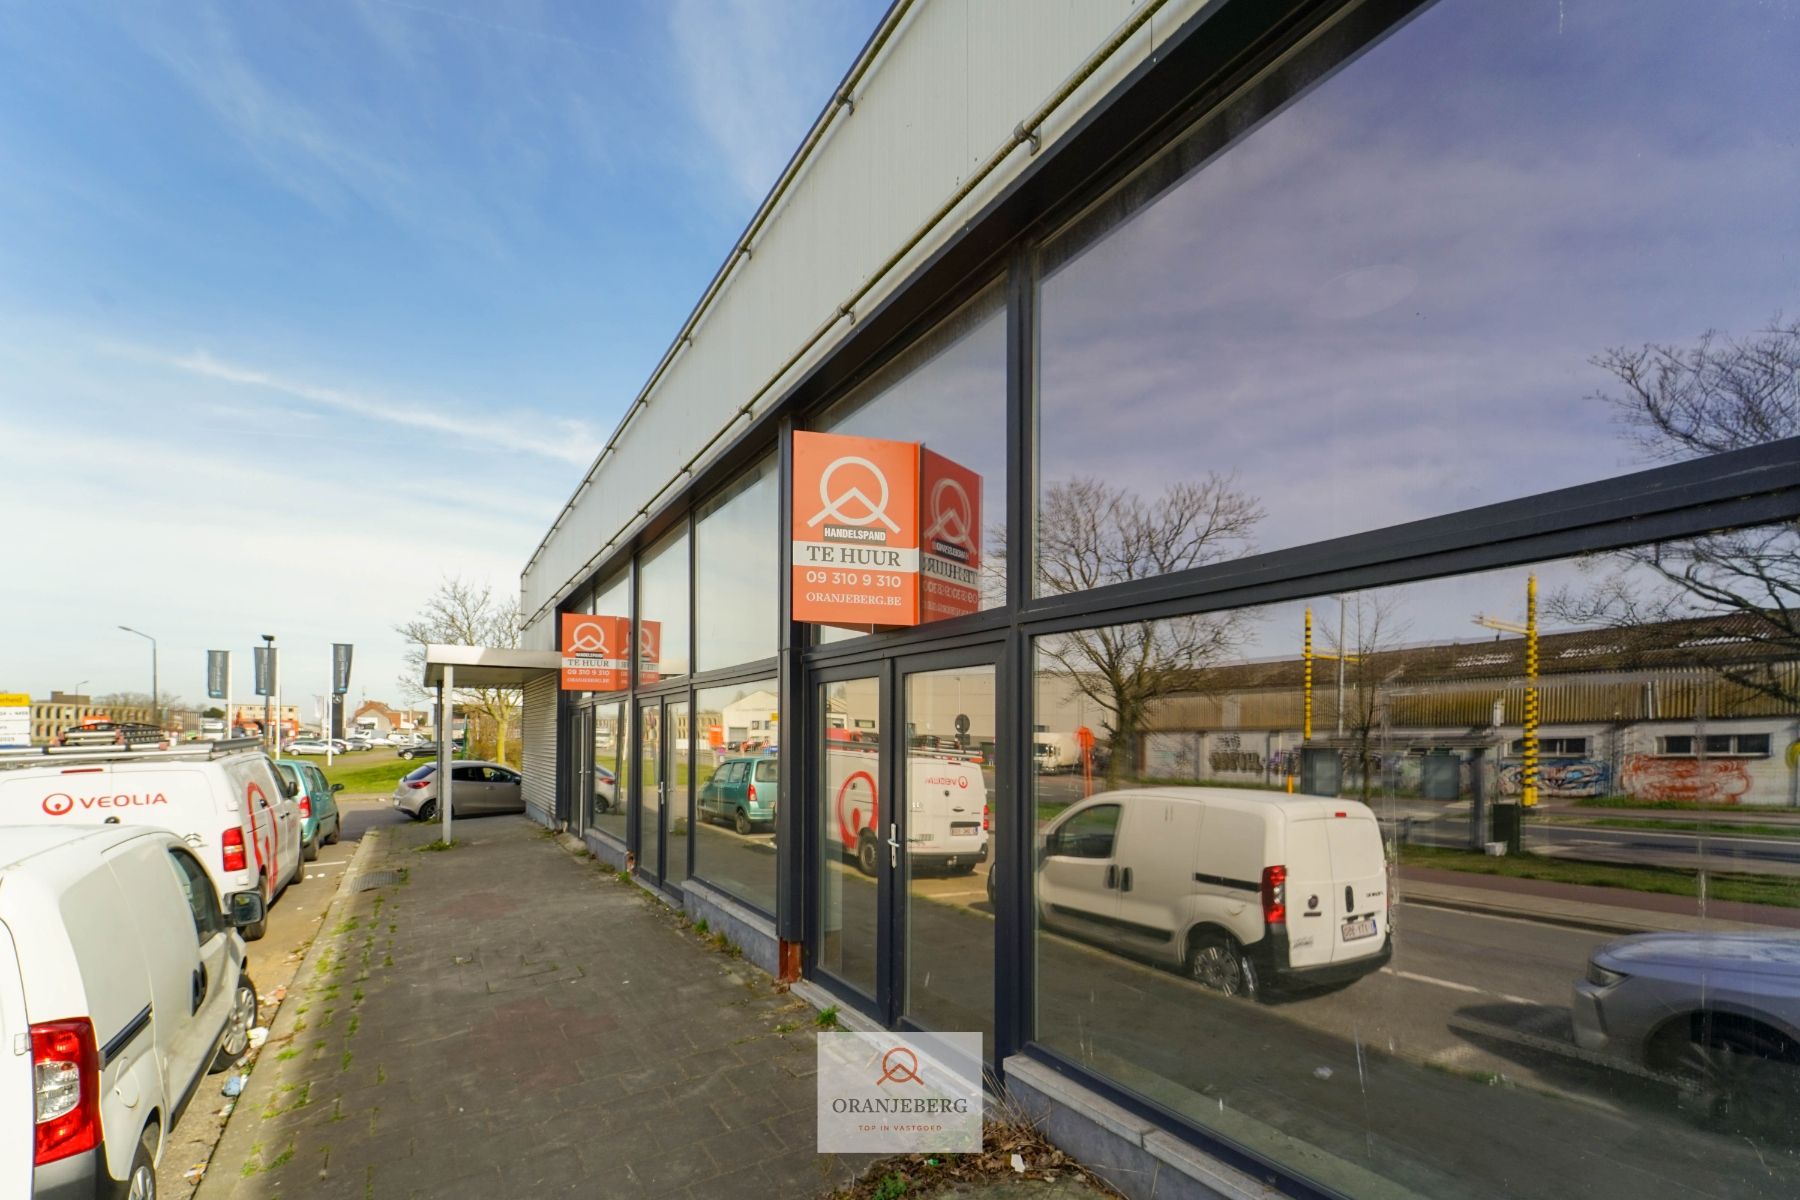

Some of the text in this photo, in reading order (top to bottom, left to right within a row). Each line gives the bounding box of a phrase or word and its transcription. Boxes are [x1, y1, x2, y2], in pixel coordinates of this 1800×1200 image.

[824, 527, 886, 541] HANDELSPAND
[806, 545, 901, 567] TE HUUR
[806, 570, 901, 588] 09 310 9 310
[806, 592, 902, 606] ORANJEBERG.BE
[567, 658, 609, 668] TE HUUR
[80, 793, 168, 809] VEOLIA
